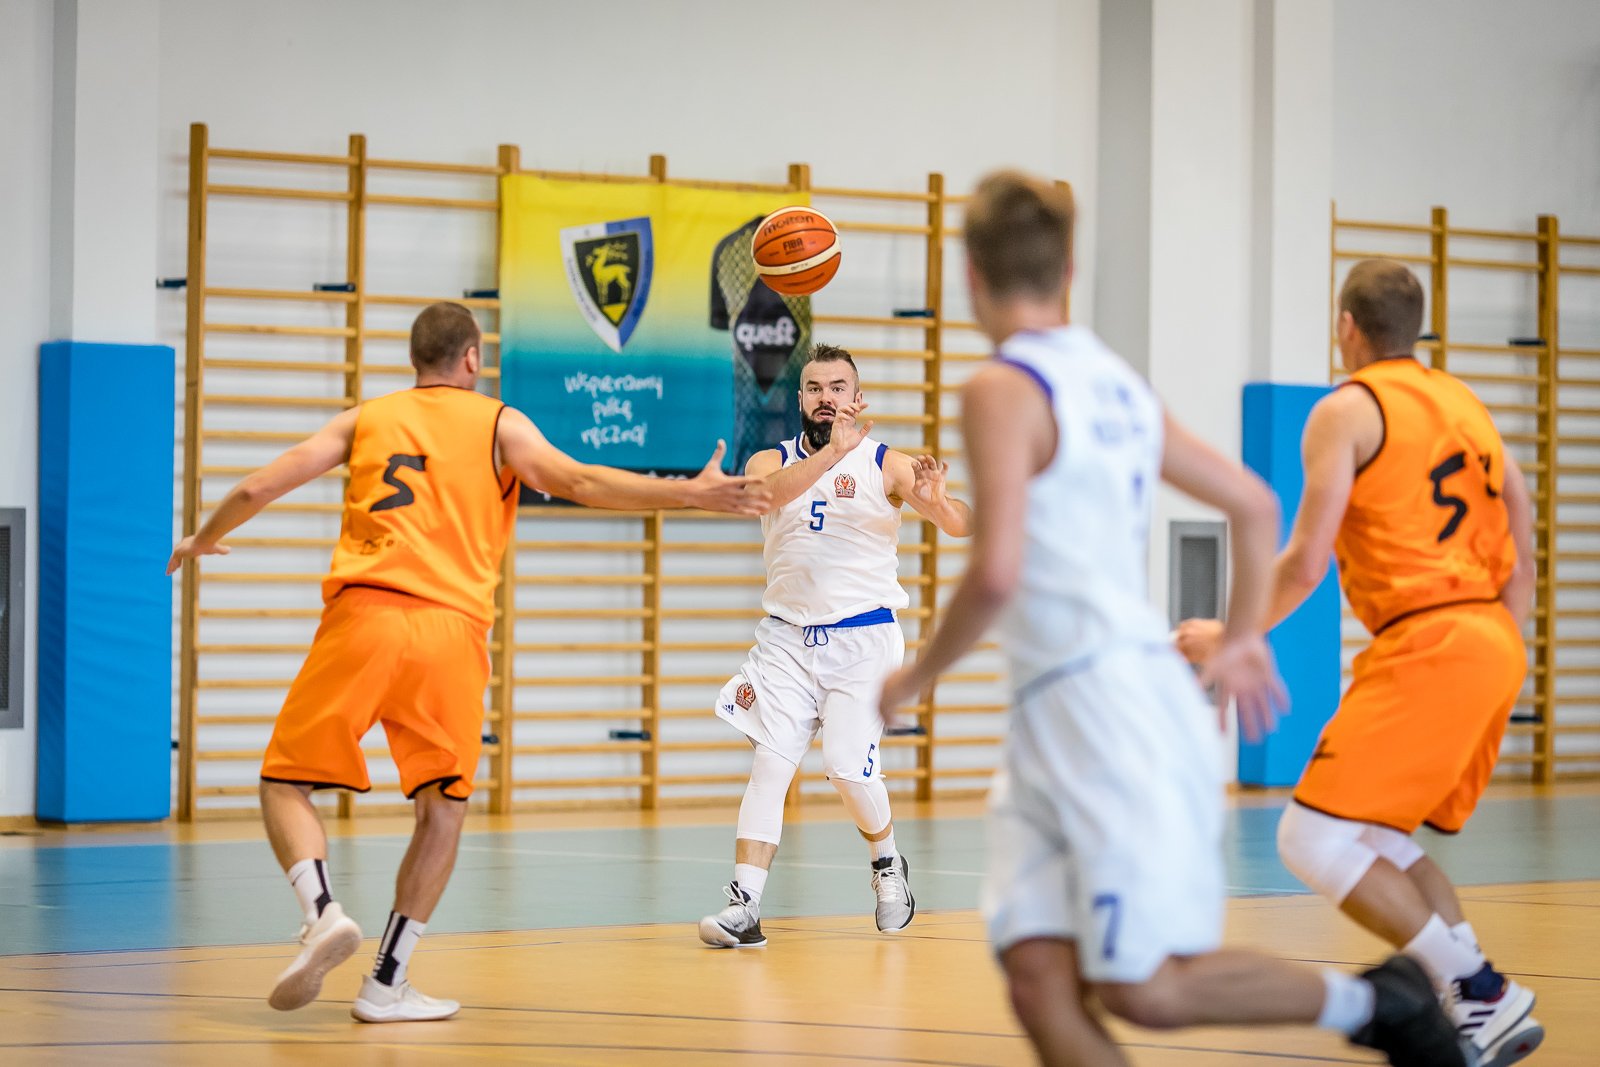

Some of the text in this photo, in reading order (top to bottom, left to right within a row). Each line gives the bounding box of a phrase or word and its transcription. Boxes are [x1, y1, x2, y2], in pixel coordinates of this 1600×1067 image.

[763, 215, 815, 236] molten
[783, 237, 804, 251] FIBA
[369, 453, 429, 513] 5
[809, 500, 827, 531] 5
[863, 743, 876, 778] 5
[1091, 892, 1125, 961] 7
